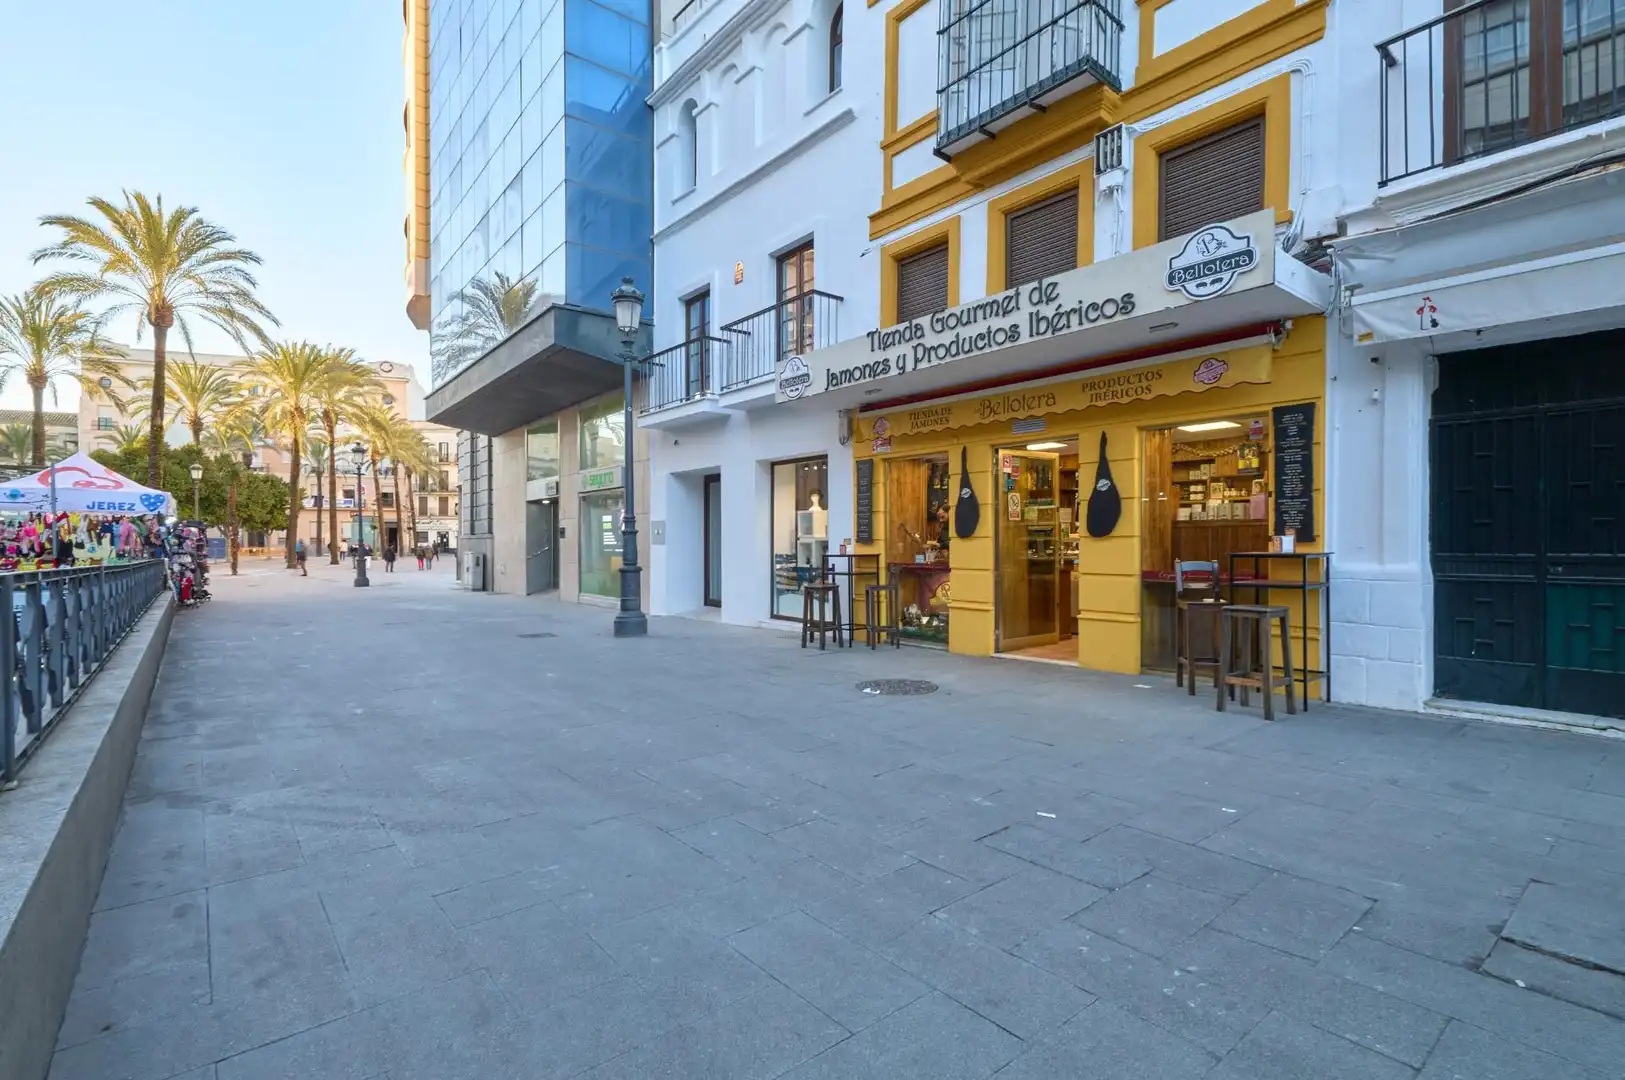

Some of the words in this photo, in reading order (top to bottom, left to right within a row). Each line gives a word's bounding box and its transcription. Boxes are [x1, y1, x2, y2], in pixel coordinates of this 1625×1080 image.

[1172, 254, 1250, 284] Bellotera
[866, 320, 925, 353] Tienda
[930, 286, 1021, 334] Gourmet
[1028, 278, 1060, 306] de
[824, 358, 892, 391] Jamones
[896, 353, 907, 375] y
[912, 322, 1021, 371] Productos
[1028, 292, 1136, 335] Ibéricos
[1081, 368, 1163, 393] PRODUCTOS
[980, 391, 1056, 419] Bellotera
[1088, 384, 1152, 404] IBÉRICOS
[908, 407, 941, 421] TIENDA
[909, 417, 950, 431] JAMONES
[86, 501, 136, 511] JEREZ
